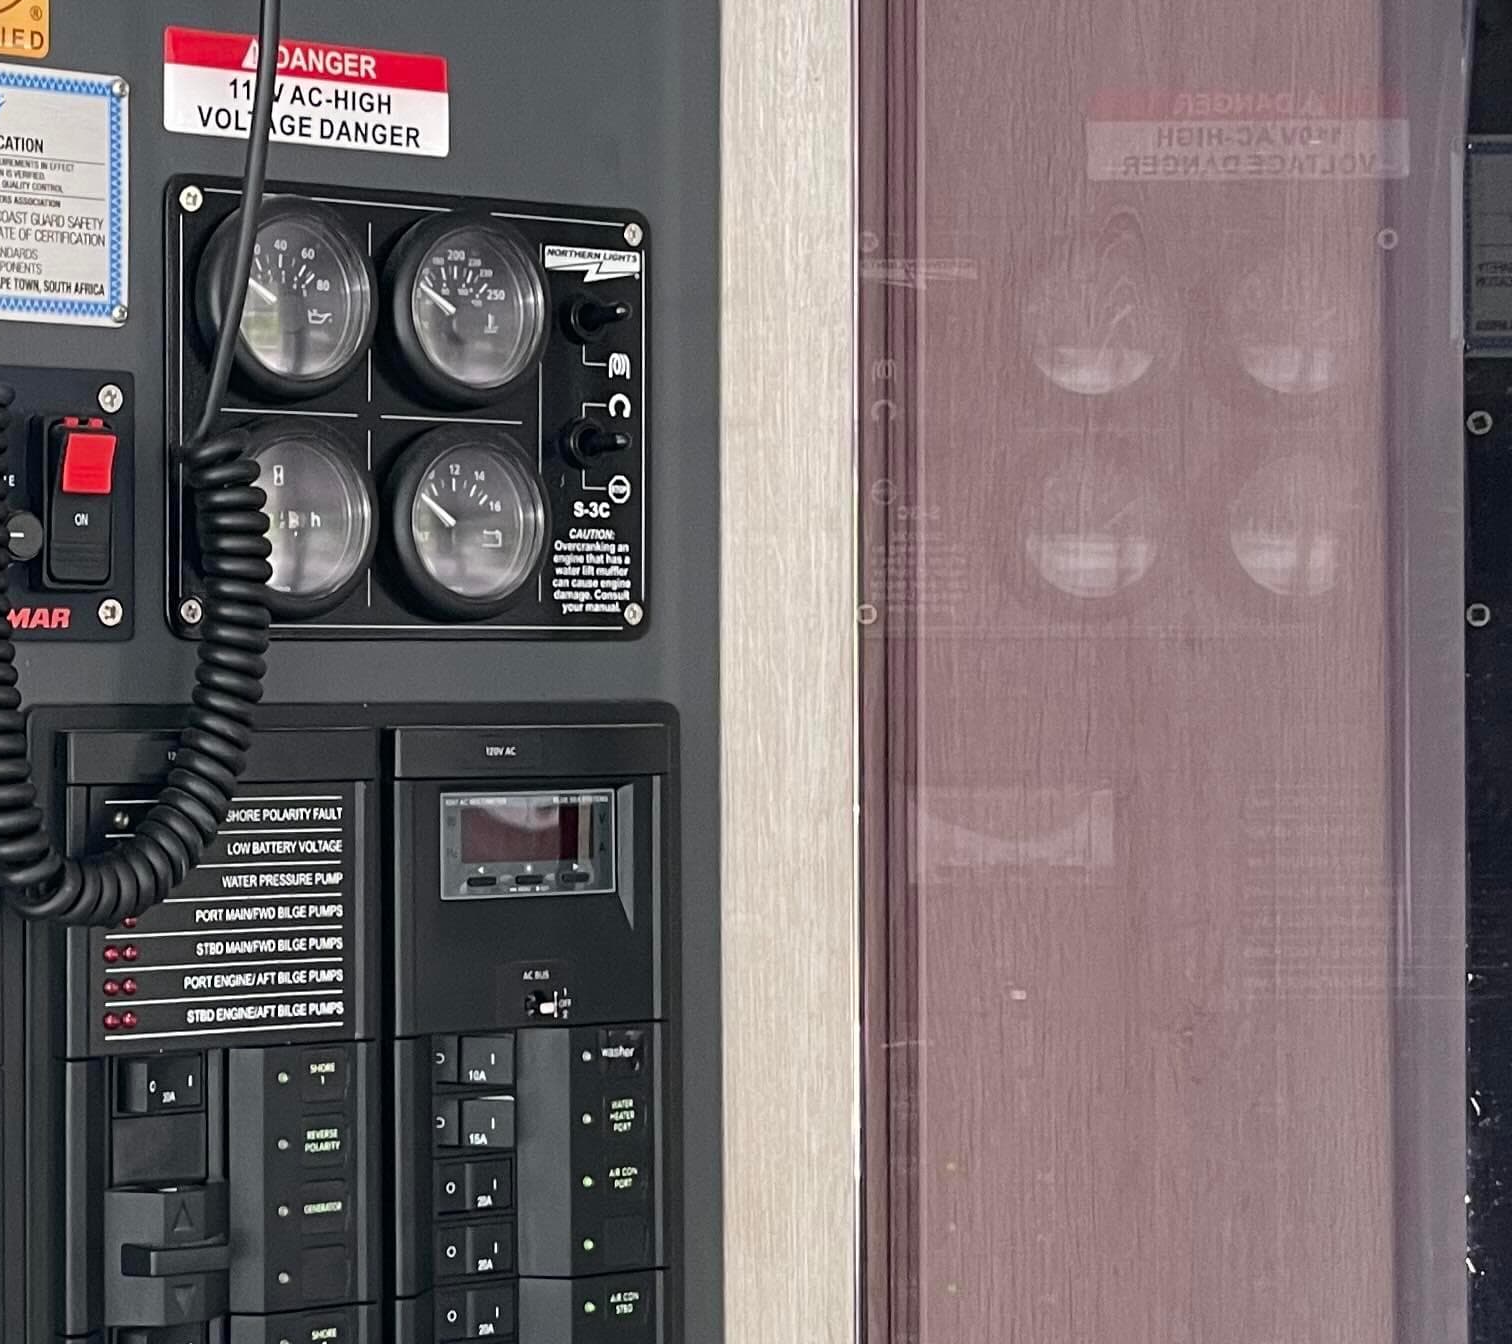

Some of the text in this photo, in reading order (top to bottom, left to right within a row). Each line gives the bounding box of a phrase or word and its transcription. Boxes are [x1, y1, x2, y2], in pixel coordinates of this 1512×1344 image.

[277, 46, 376, 78] DANGER
[290, 86, 391, 114] AC-HIGH
[320, 119, 420, 148] DANGER
[274, 240, 287, 251] 40
[301, 248, 315, 259] 60
[447, 250, 465, 261] 200
[547, 249, 637, 262] NORTHERN LIGHTS
[316, 280, 330, 291] 80
[450, 464, 460, 474] 12
[574, 501, 610, 518] S-3C
[75, 513, 88, 526] ON
[228, 840, 342, 855] LOW BATTERY VOLTAGE
[222, 873, 343, 888] WATER PRESSURE PUMP
